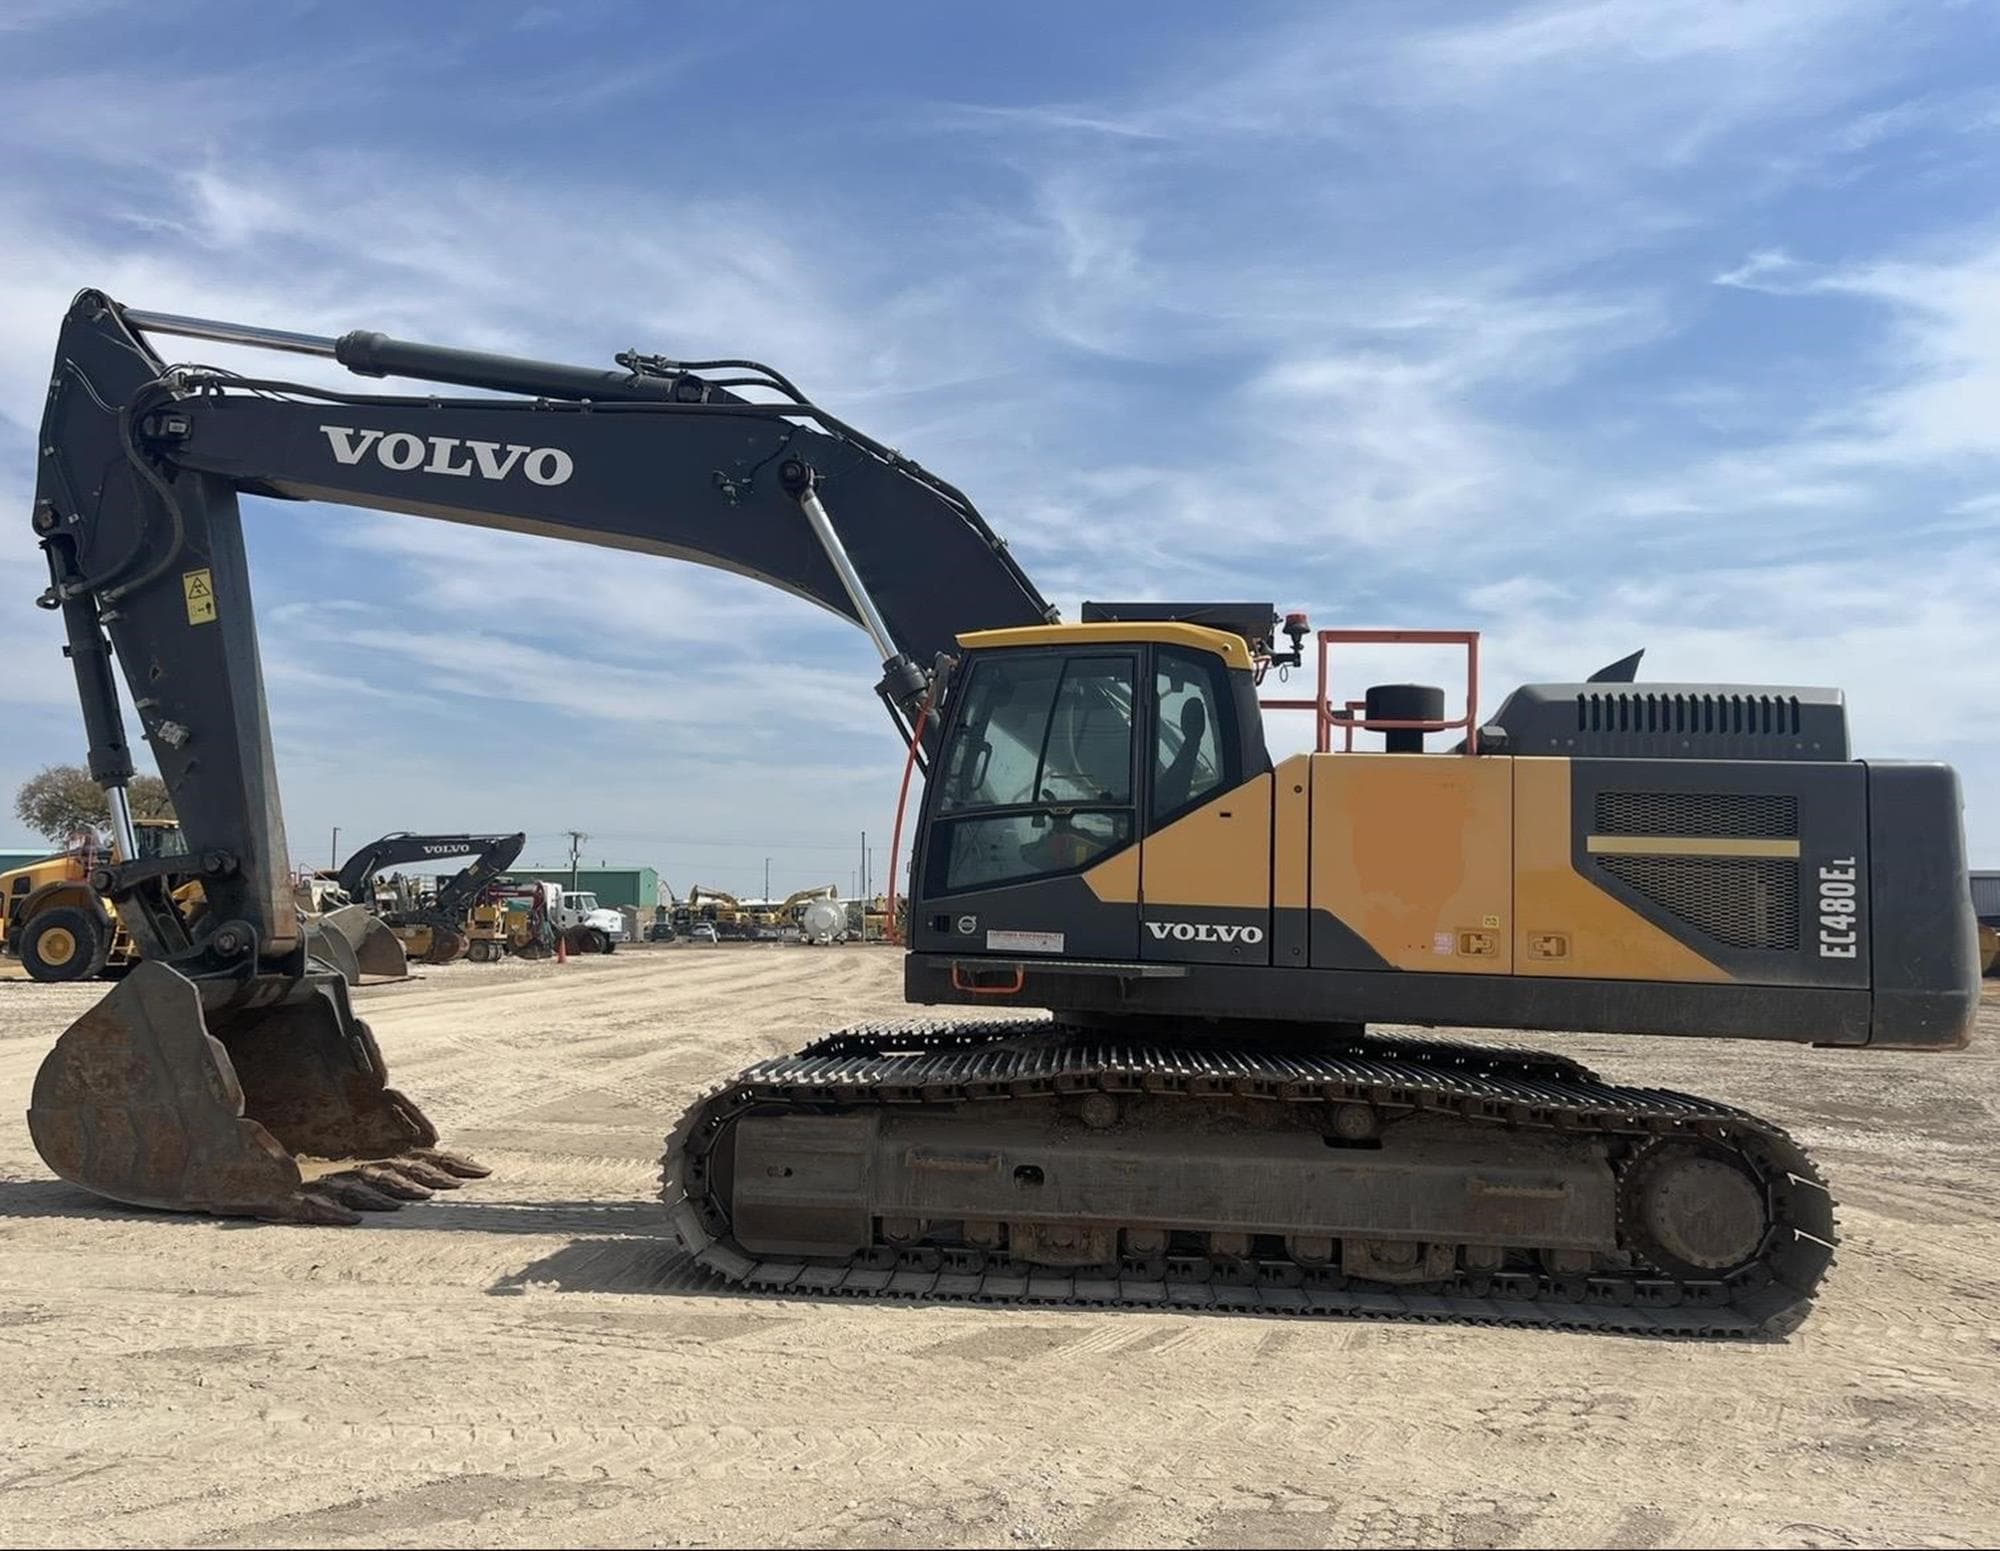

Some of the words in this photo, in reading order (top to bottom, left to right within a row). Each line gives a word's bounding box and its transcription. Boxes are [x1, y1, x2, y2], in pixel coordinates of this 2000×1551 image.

[319, 425, 574, 486] VOLVO
[423, 844, 470, 854] VOLVO
[1145, 922, 1264, 944] VOLVO
